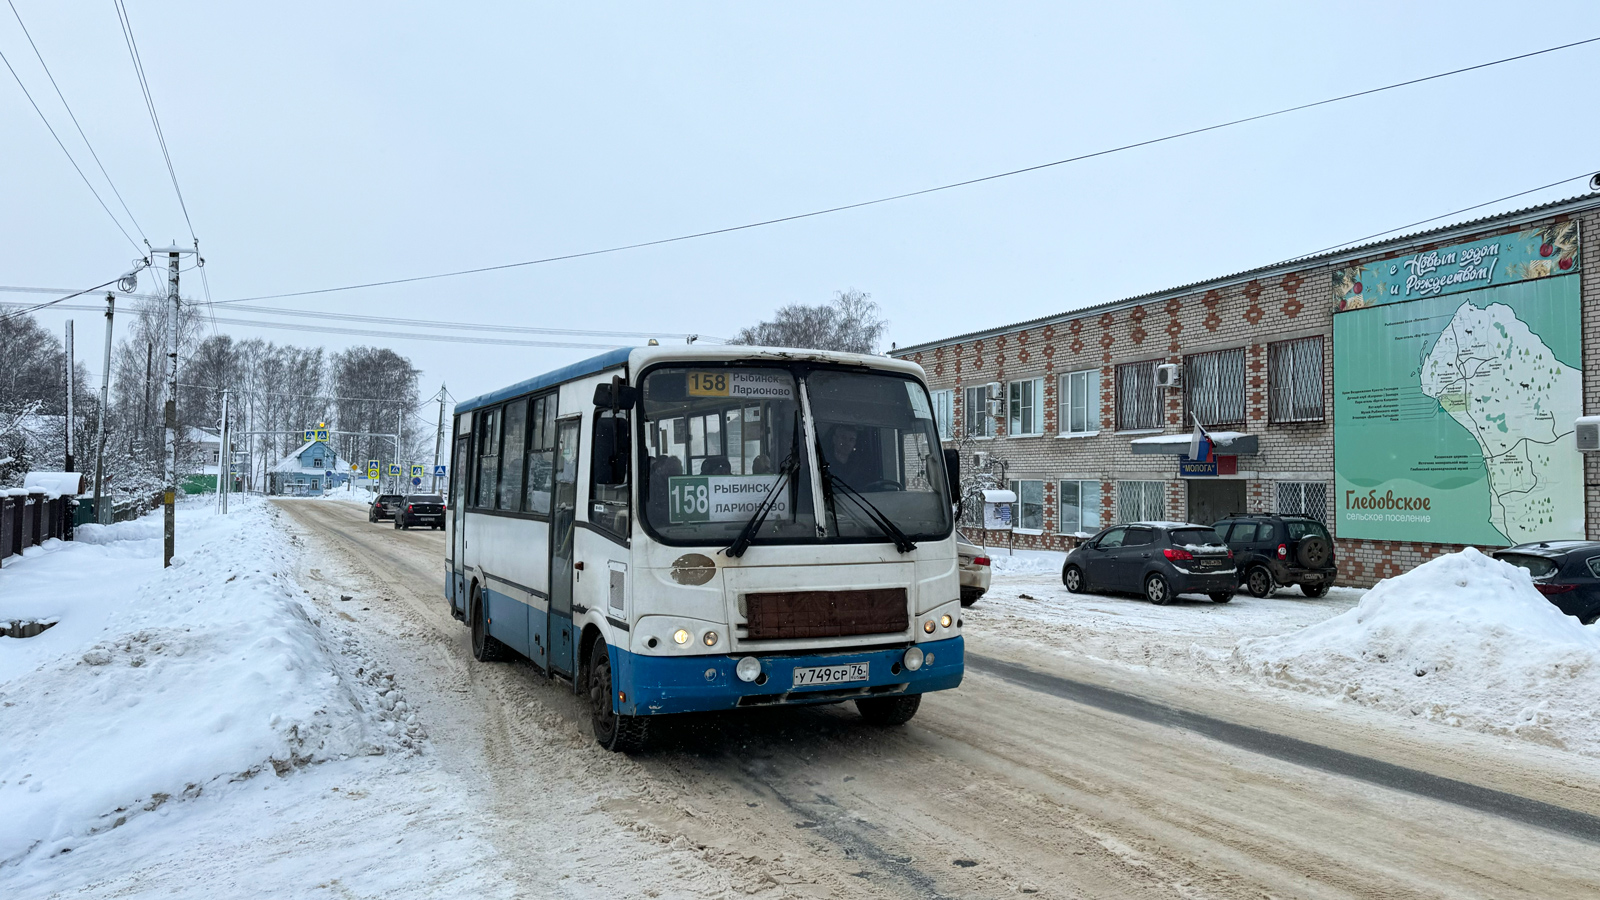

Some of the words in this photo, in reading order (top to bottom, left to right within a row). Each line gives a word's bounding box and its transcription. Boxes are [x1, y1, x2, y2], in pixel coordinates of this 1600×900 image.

[1390, 264, 1398, 275] с
[1404, 251, 1456, 276] Новым
[1460, 243, 1499, 267] годом
[1390, 284, 1399, 295] и
[1405, 257, 1498, 295] Рождеством!
[690, 373, 726, 391] 158
[733, 385, 790, 396] Ларионово
[714, 484, 771, 493] РЫБИНСК
[671, 484, 709, 515] 158
[1346, 489, 1431, 510] Глебовское
[1346, 512, 1383, 521] сельское
[1385, 514, 1431, 523] поселение
[851, 665, 863, 676] 76
